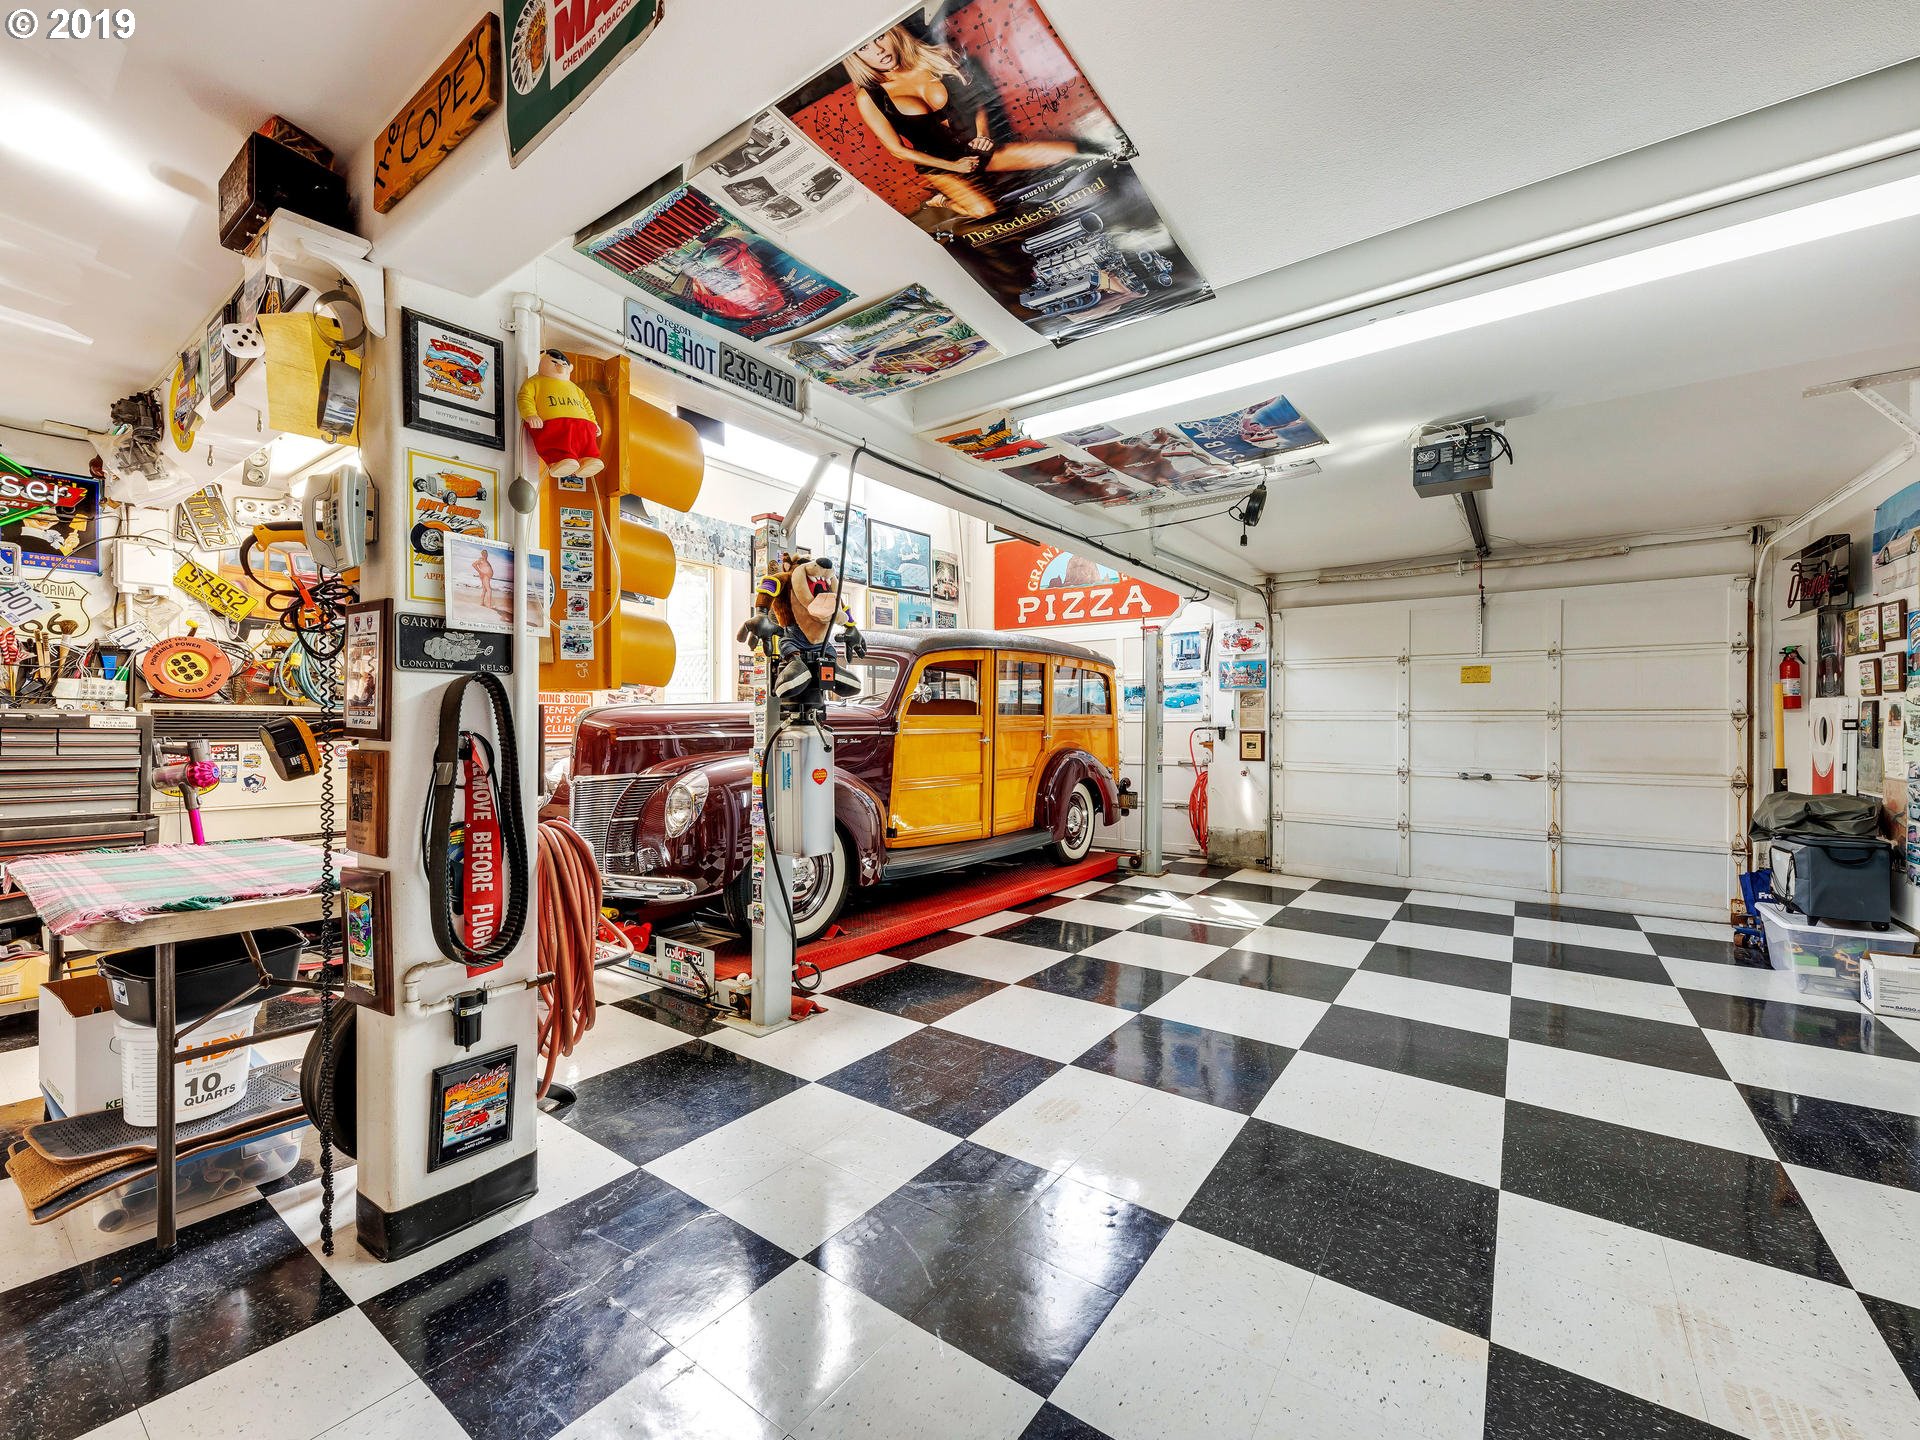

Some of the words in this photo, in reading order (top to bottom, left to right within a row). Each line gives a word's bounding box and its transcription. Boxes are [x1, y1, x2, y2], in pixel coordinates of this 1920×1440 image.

[562, 34, 597, 71] CHEWING
[597, 0, 633, 37] TOBACCO
[401, 26, 486, 164] COPE'S
[963, 226, 994, 245] The
[992, 206, 1051, 239] Rodder's
[1049, 178, 1106, 216] Journal
[700, 217, 723, 234] TOUR
[656, 314, 692, 337] Oregon
[630, 315, 667, 354] SOO
[682, 336, 716, 375] HOT
[724, 350, 794, 404] 236-470
[416, 497, 447, 513] HOT
[446, 503, 481, 519] RODS
[0, 587, 43, 616] HOT
[1017, 585, 1152, 624] PIZZA
[151, 643, 174, 666] PORTABLE
[175, 641, 202, 649] POWER
[402, 660, 454, 669] LONGVIEW
[480, 664, 510, 672] KELSO
[178, 686, 204, 694] CORD
[206, 673, 222, 689] REEL
[564, 694, 590, 705] SOON!
[545, 724, 572, 733] CLUB
[471, 831, 493, 893] BEFORE
[471, 903, 493, 949] FLIGH
[183, 1083, 236, 1107] QUARTS
[185, 1072, 222, 1097] 10
